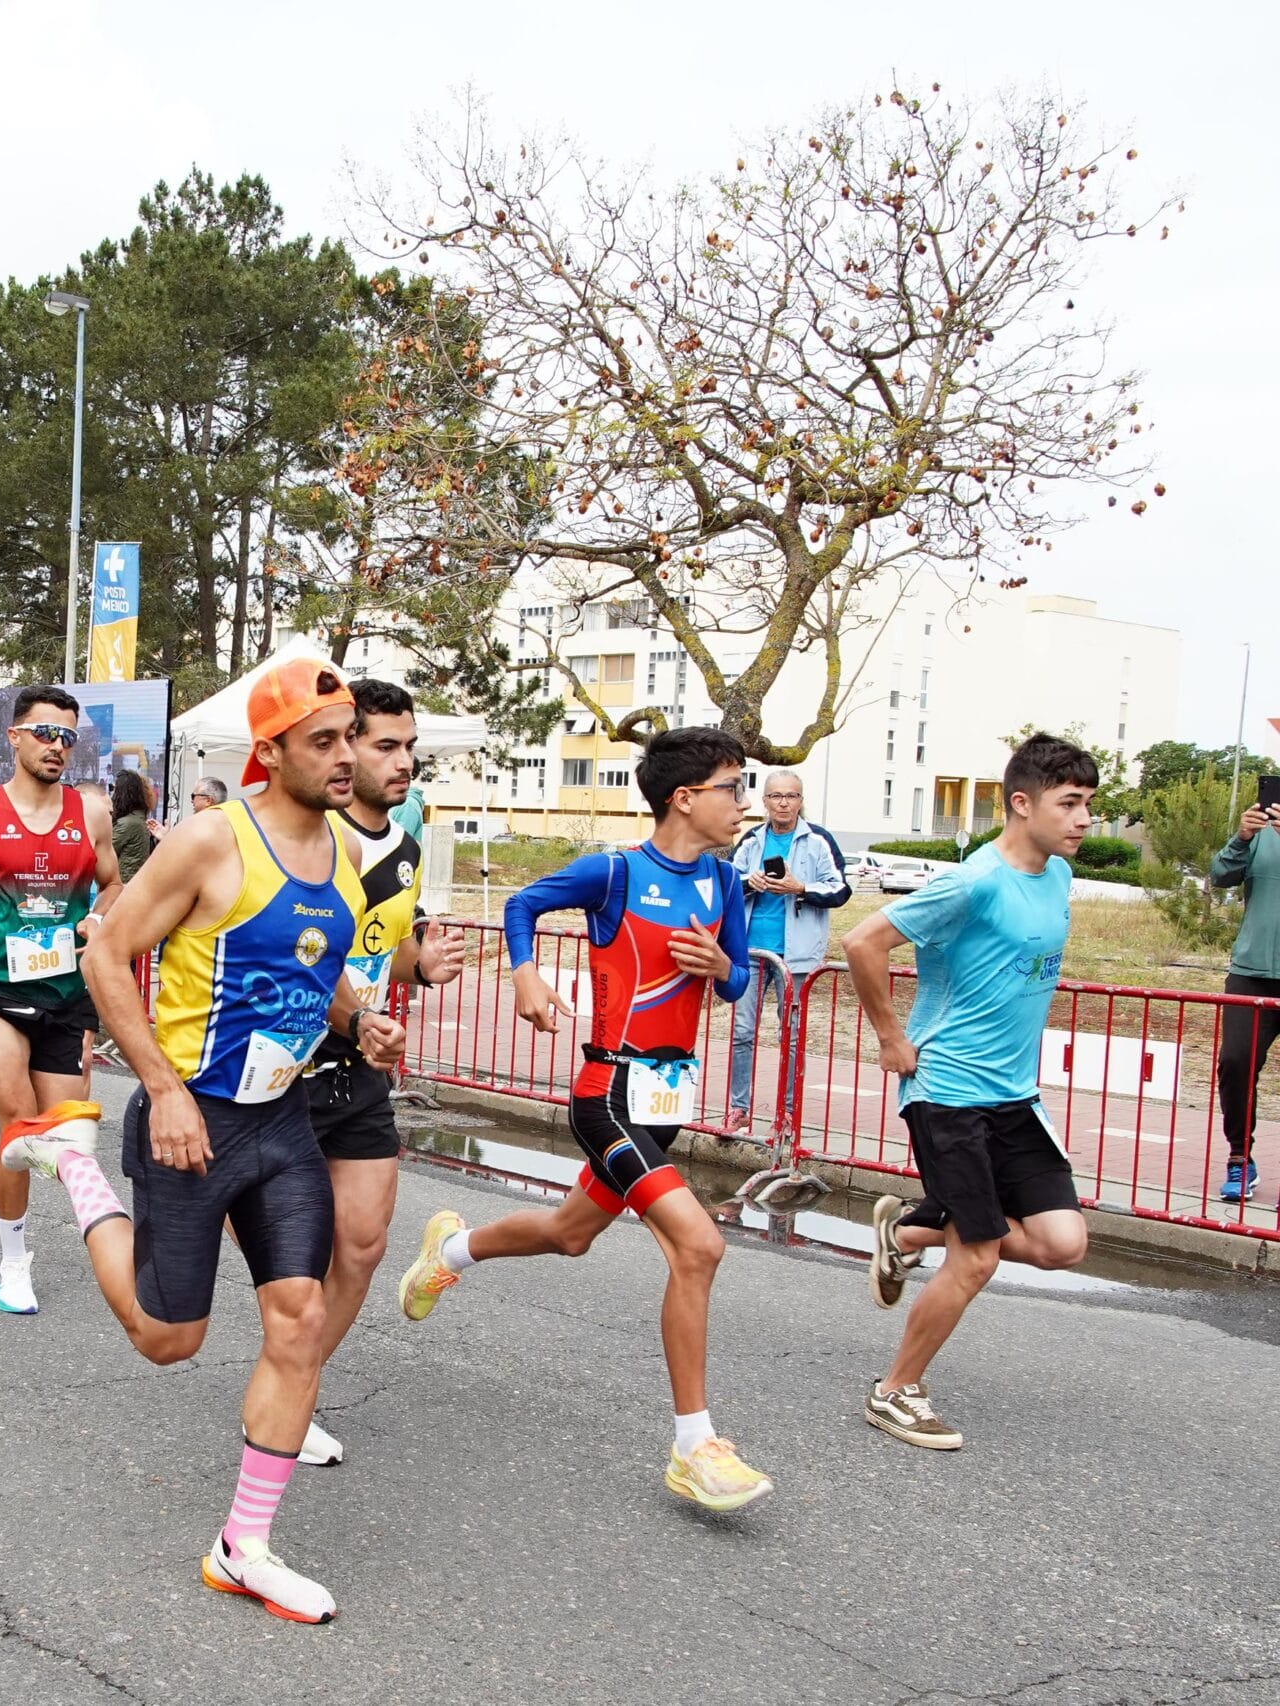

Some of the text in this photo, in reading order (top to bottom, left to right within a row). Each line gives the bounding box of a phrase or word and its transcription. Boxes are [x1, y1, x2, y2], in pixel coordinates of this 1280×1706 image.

[14, 873, 69, 881] TERESA LEDO
[27, 951, 60, 972] 390
[599, 972, 609, 1011] CLUB
[649, 1091, 681, 1116] 301
